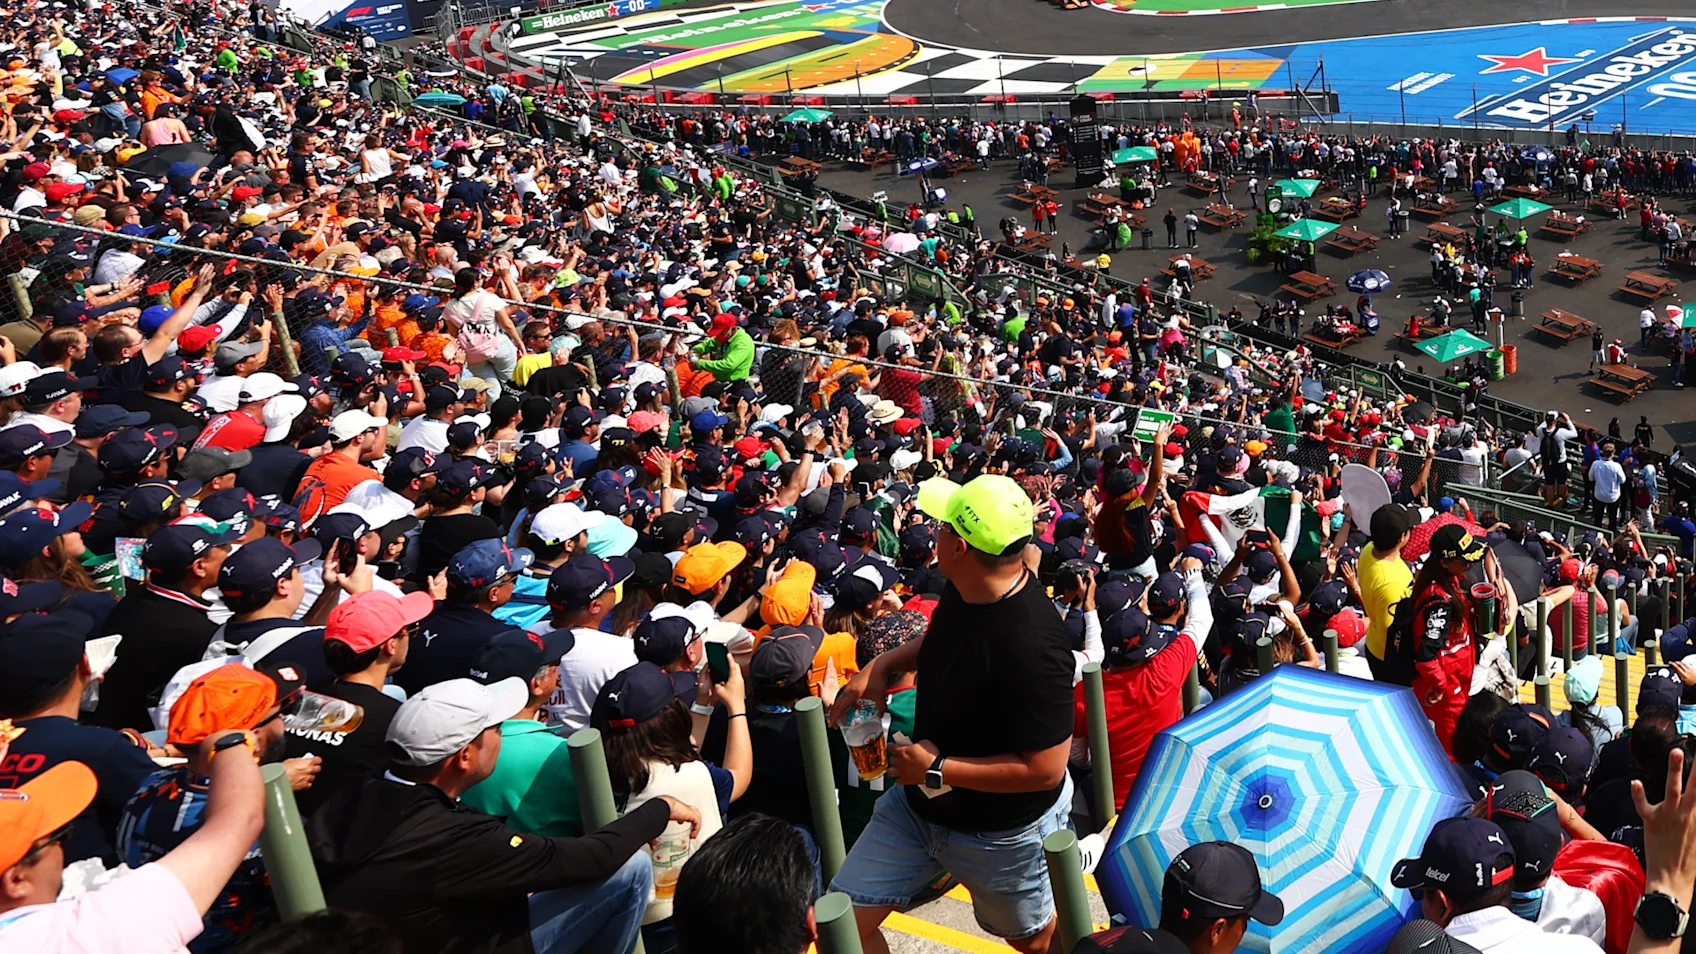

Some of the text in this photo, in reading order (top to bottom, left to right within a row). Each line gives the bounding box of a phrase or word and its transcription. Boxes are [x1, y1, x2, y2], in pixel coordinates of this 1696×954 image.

[541, 4, 605, 29] Heineken
[636, 8, 805, 45] Heineken
[0, 491, 22, 510] AVAK
[967, 509, 980, 523] FTX
[545, 690, 566, 706] ull
[0, 753, 47, 774] CO
[1425, 865, 1452, 883] telcel
